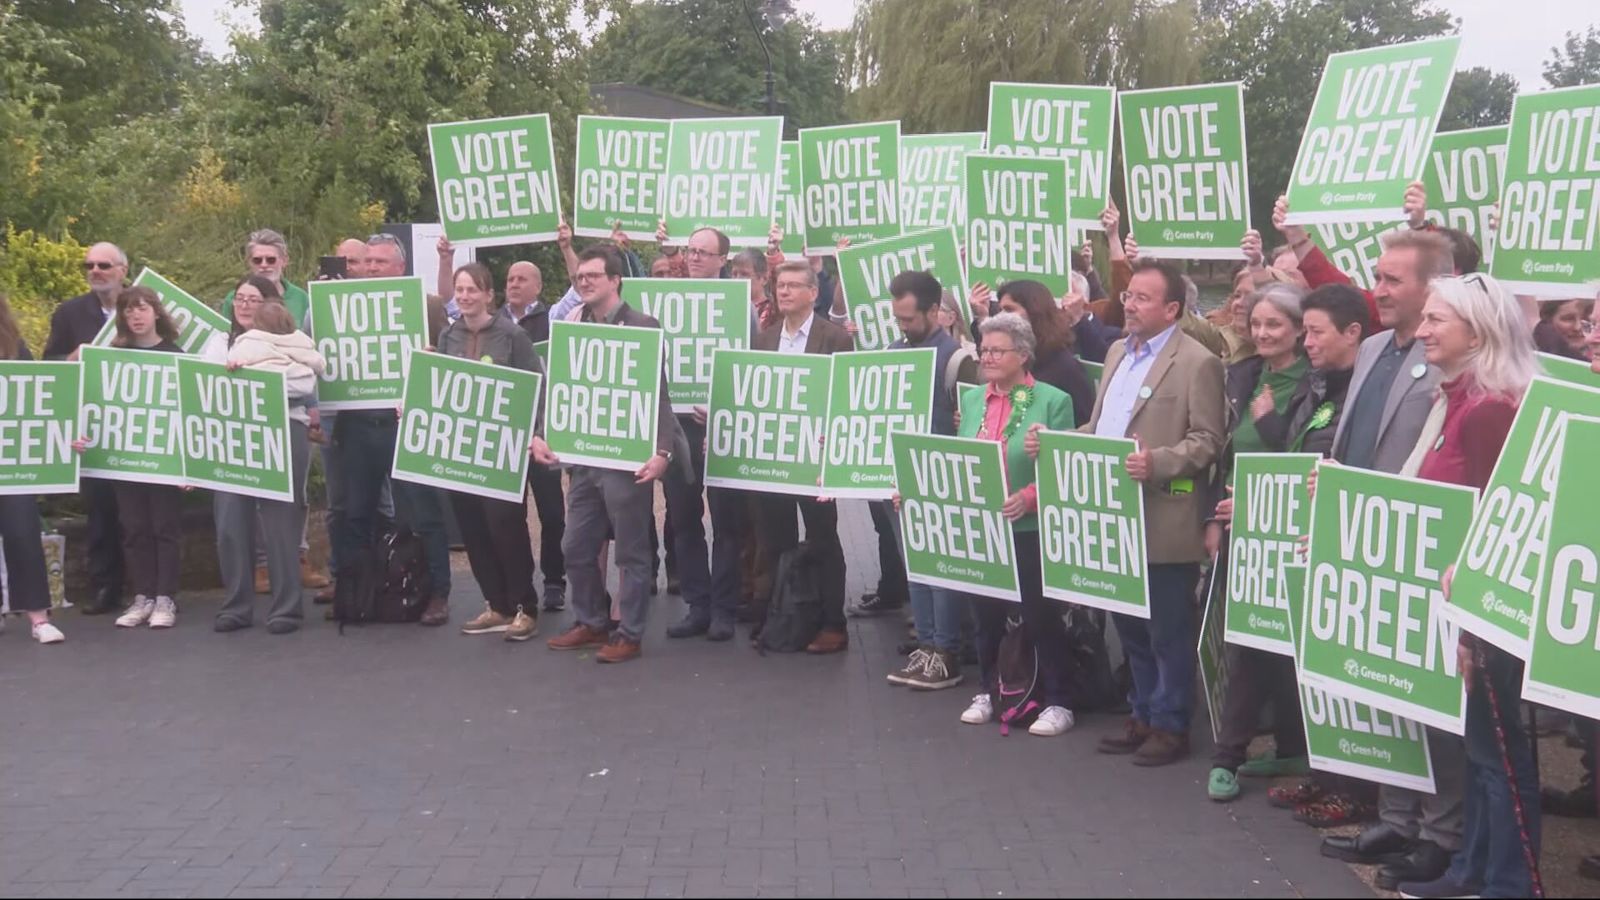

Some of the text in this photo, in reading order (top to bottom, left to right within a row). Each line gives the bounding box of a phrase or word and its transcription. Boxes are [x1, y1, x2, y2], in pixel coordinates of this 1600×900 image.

[1335, 56, 1433, 121] VOTE
[1012, 97, 1091, 145] VOTE
[1140, 102, 1221, 160] VOTE
[451, 128, 532, 174] VOTE
[596, 128, 666, 170] VOTE
[689, 130, 760, 171] VOTE
[817, 135, 882, 180] VOTE
[901, 145, 964, 184] VOTE
[1299, 116, 1431, 186] GREEN
[442, 169, 554, 223] GREEN
[669, 172, 771, 218] GREEN
[982, 169, 1050, 219] VOTE
[1130, 161, 1242, 222] GREEN
[1433, 144, 1506, 203] VOT
[806, 178, 897, 229] GREEN
[900, 185, 966, 227] REEN
[1334, 191, 1377, 203] Green Party
[490, 222, 528, 232] Green Party
[970, 218, 1064, 275] GREEN
[1175, 229, 1214, 241] Green Party
[1534, 261, 1574, 276] Green Party
[329, 290, 405, 333] VOTE
[640, 291, 725, 334] VOTE
[100, 360, 177, 407] VOTE
[568, 336, 641, 386] VOTE
[195, 371, 267, 423] VOTE
[360, 386, 397, 395] Green Party
[430, 366, 515, 422] VOTE
[668, 391, 690, 399] Green
[732, 363, 811, 412] VOTE
[848, 363, 917, 412] VOTE
[550, 382, 652, 442] GREEN
[0, 419, 73, 465] EEN
[185, 415, 285, 473] GREEN
[403, 407, 525, 473] GREEN
[586, 442, 622, 456] Green Party
[712, 408, 824, 466] GREEN
[15, 472, 38, 481] Party
[120, 457, 159, 470] Green Party
[225, 470, 260, 484] Green Party
[445, 466, 487, 483] Green Party
[751, 466, 790, 479] Green Party
[861, 474, 878, 482] Green
[909, 447, 987, 505] VOTE
[1053, 448, 1123, 510] VOTE
[1247, 473, 1302, 536] VOTE
[903, 499, 1010, 567] GREEN
[1043, 504, 1140, 578] GREEN
[1338, 489, 1443, 582] VOTE
[1466, 485, 1550, 597] GRE
[948, 564, 984, 581] Green Party
[1082, 576, 1117, 594] Green Party
[1231, 536, 1306, 611] GREE
[1256, 617, 1285, 634] Green Party
[1311, 561, 1461, 679] GREEN
[1494, 599, 1532, 628] Green Par
[1361, 665, 1414, 693] Green Party
[1351, 742, 1391, 763] Green Party
